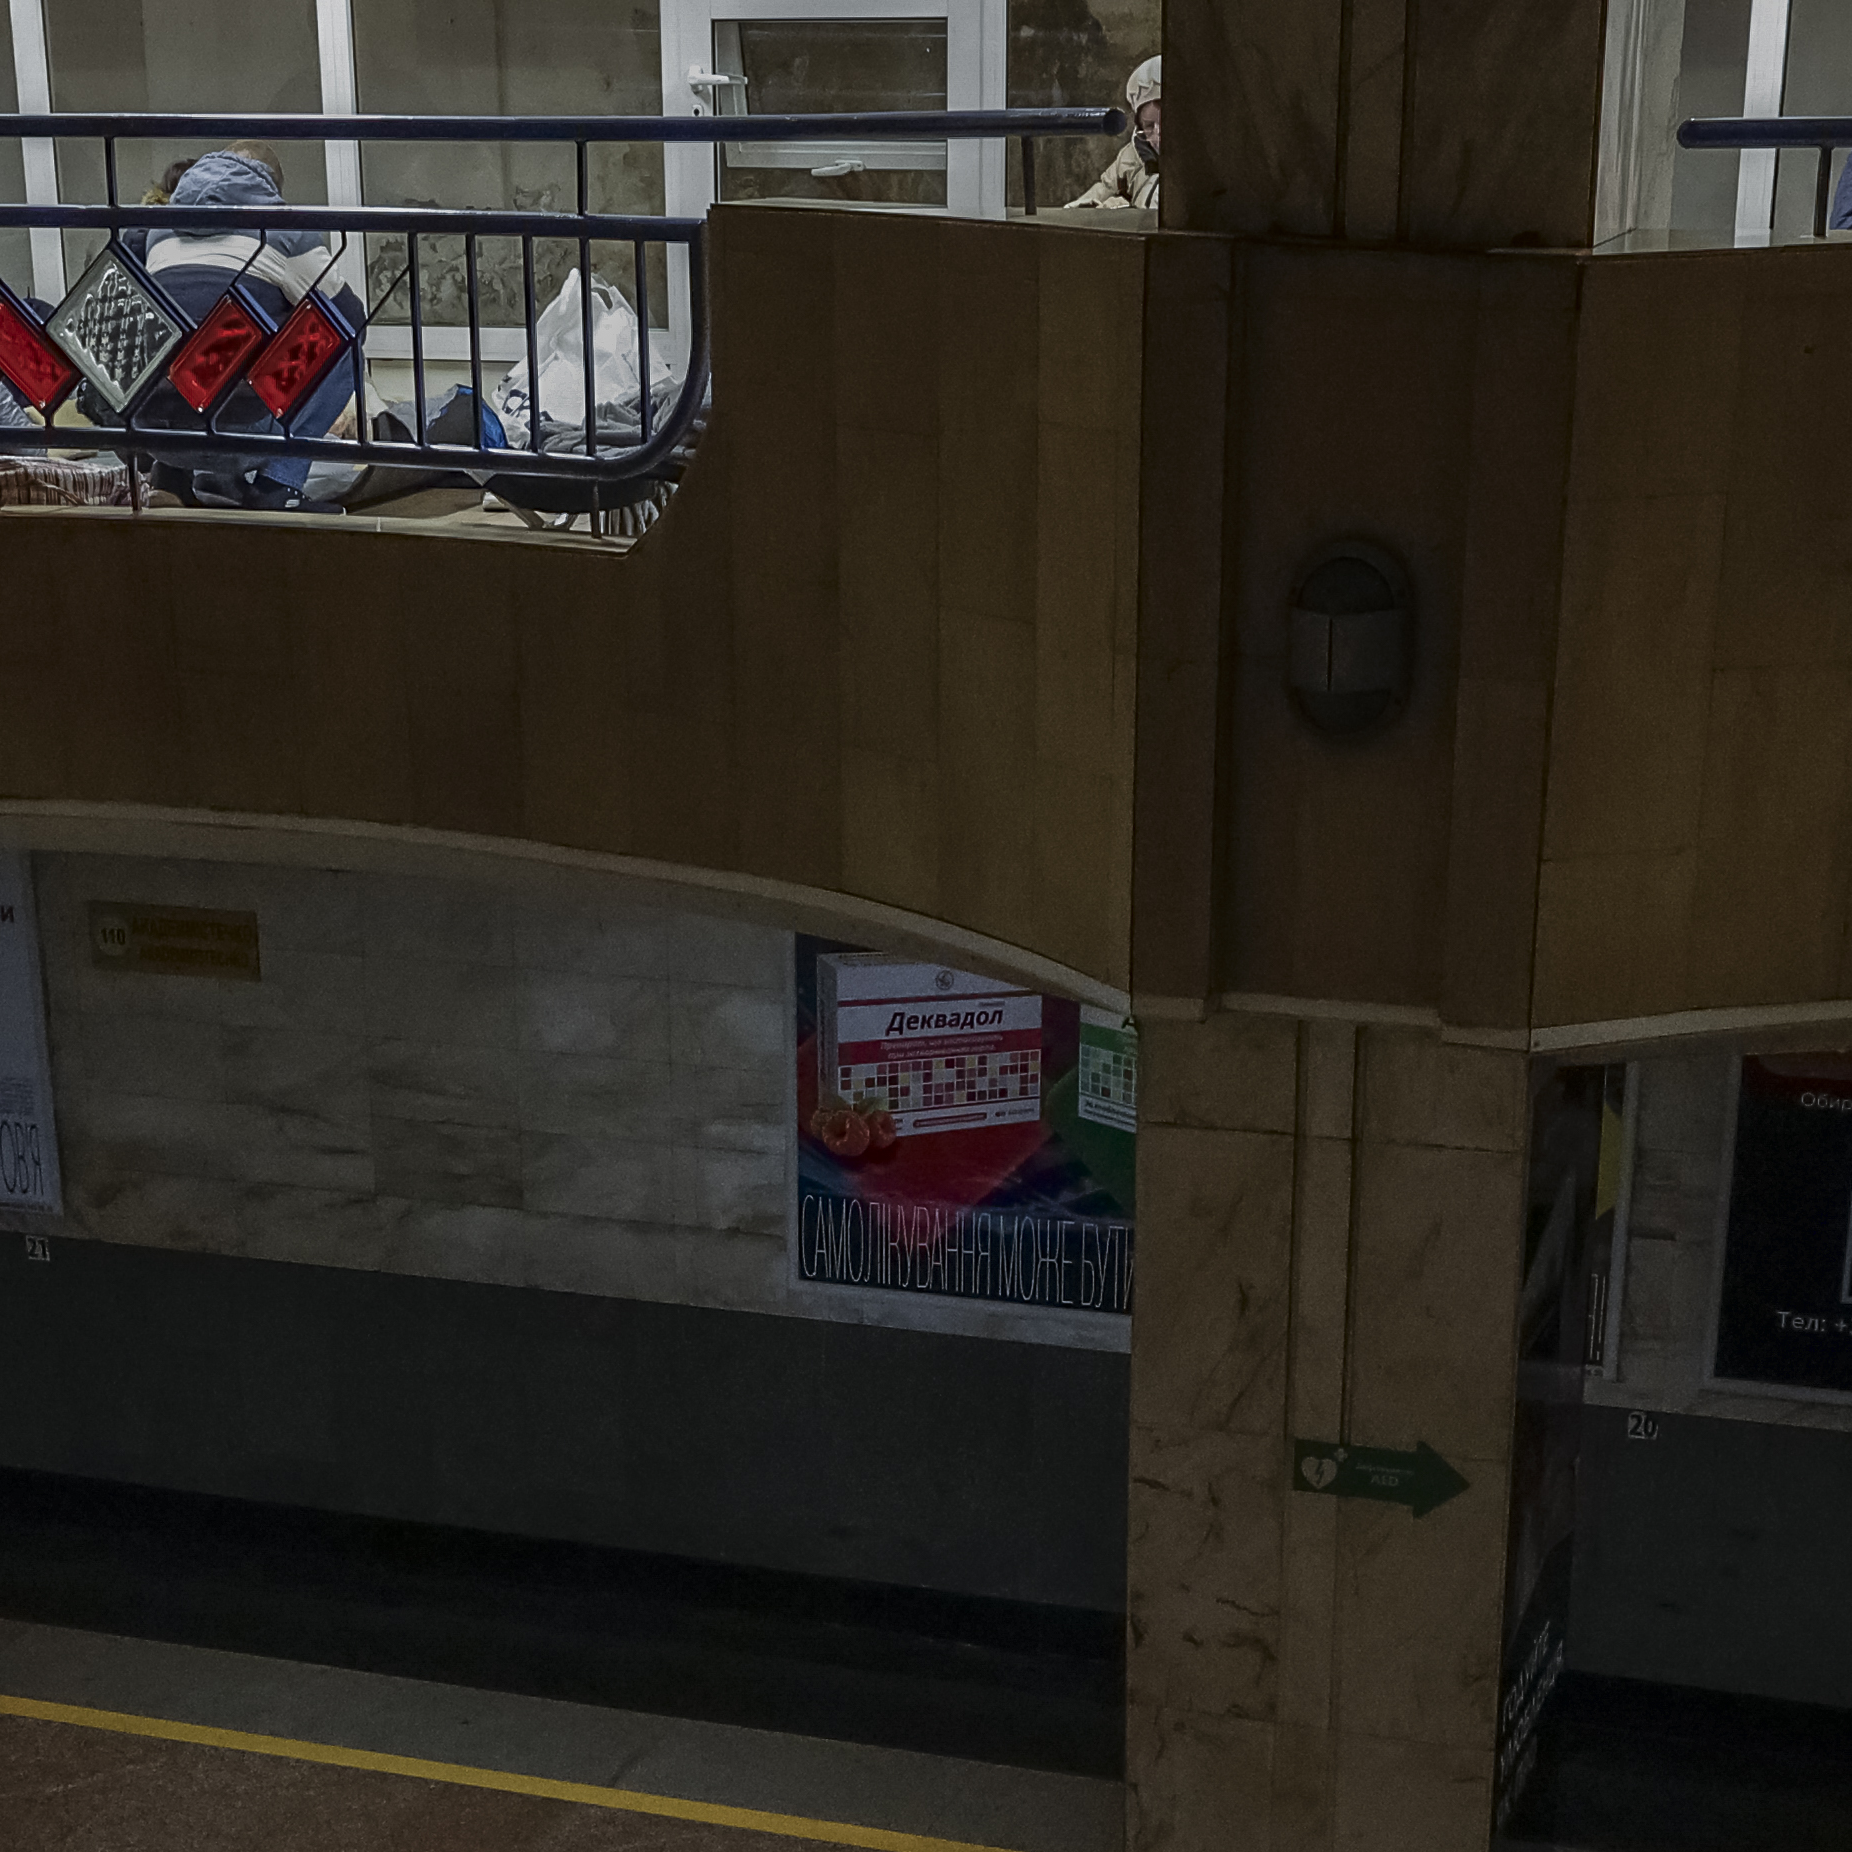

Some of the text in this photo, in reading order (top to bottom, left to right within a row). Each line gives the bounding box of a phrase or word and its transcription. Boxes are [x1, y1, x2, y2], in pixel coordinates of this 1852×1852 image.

[101, 927, 126, 945] 110
[885, 1009, 1004, 1037] Деквадол
[28, 1239, 47, 1258] 21
[801, 1194, 992, 1297] САМОЛІКУВАННЯ
[998, 1214, 1075, 1306] МОЖЕ
[1778, 1311, 1826, 1332] Тел:
[1629, 1414, 1656, 1437] 20
